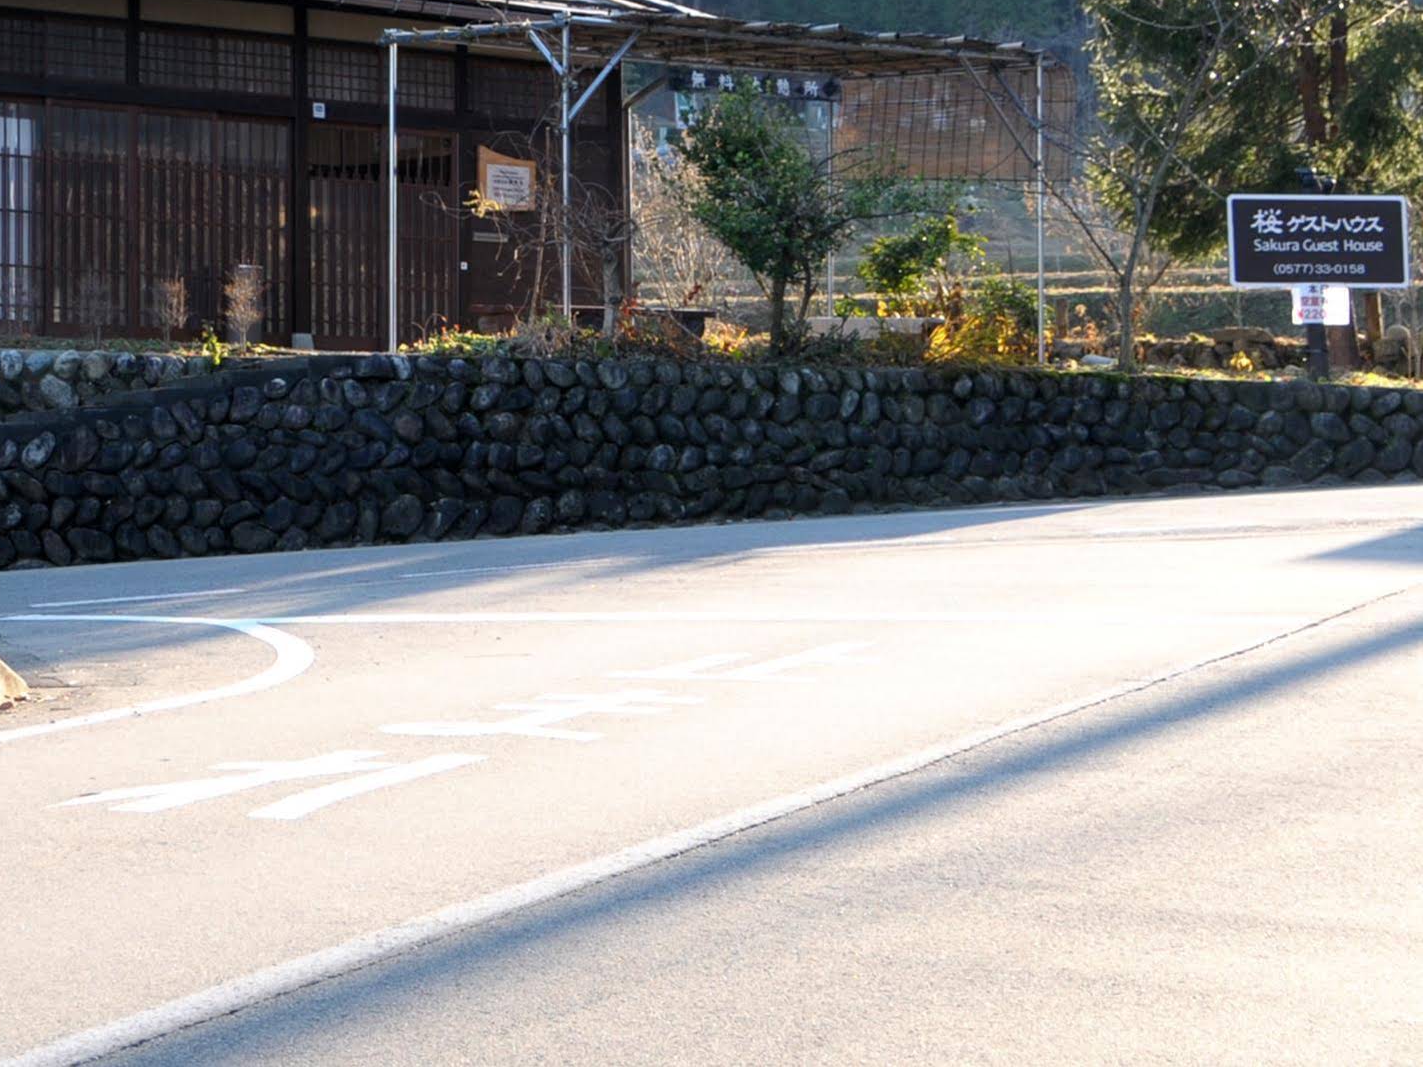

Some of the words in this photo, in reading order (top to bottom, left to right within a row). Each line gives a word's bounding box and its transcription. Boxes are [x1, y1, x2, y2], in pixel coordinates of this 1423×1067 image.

[1250, 208, 1384, 234] 桜ゲストハウス
[1253, 238, 1300, 252] Sakura
[1303, 238, 1339, 252] Guest
[1343, 238, 1384, 252] House
[1273, 263, 1366, 275] (0577)33-0158
